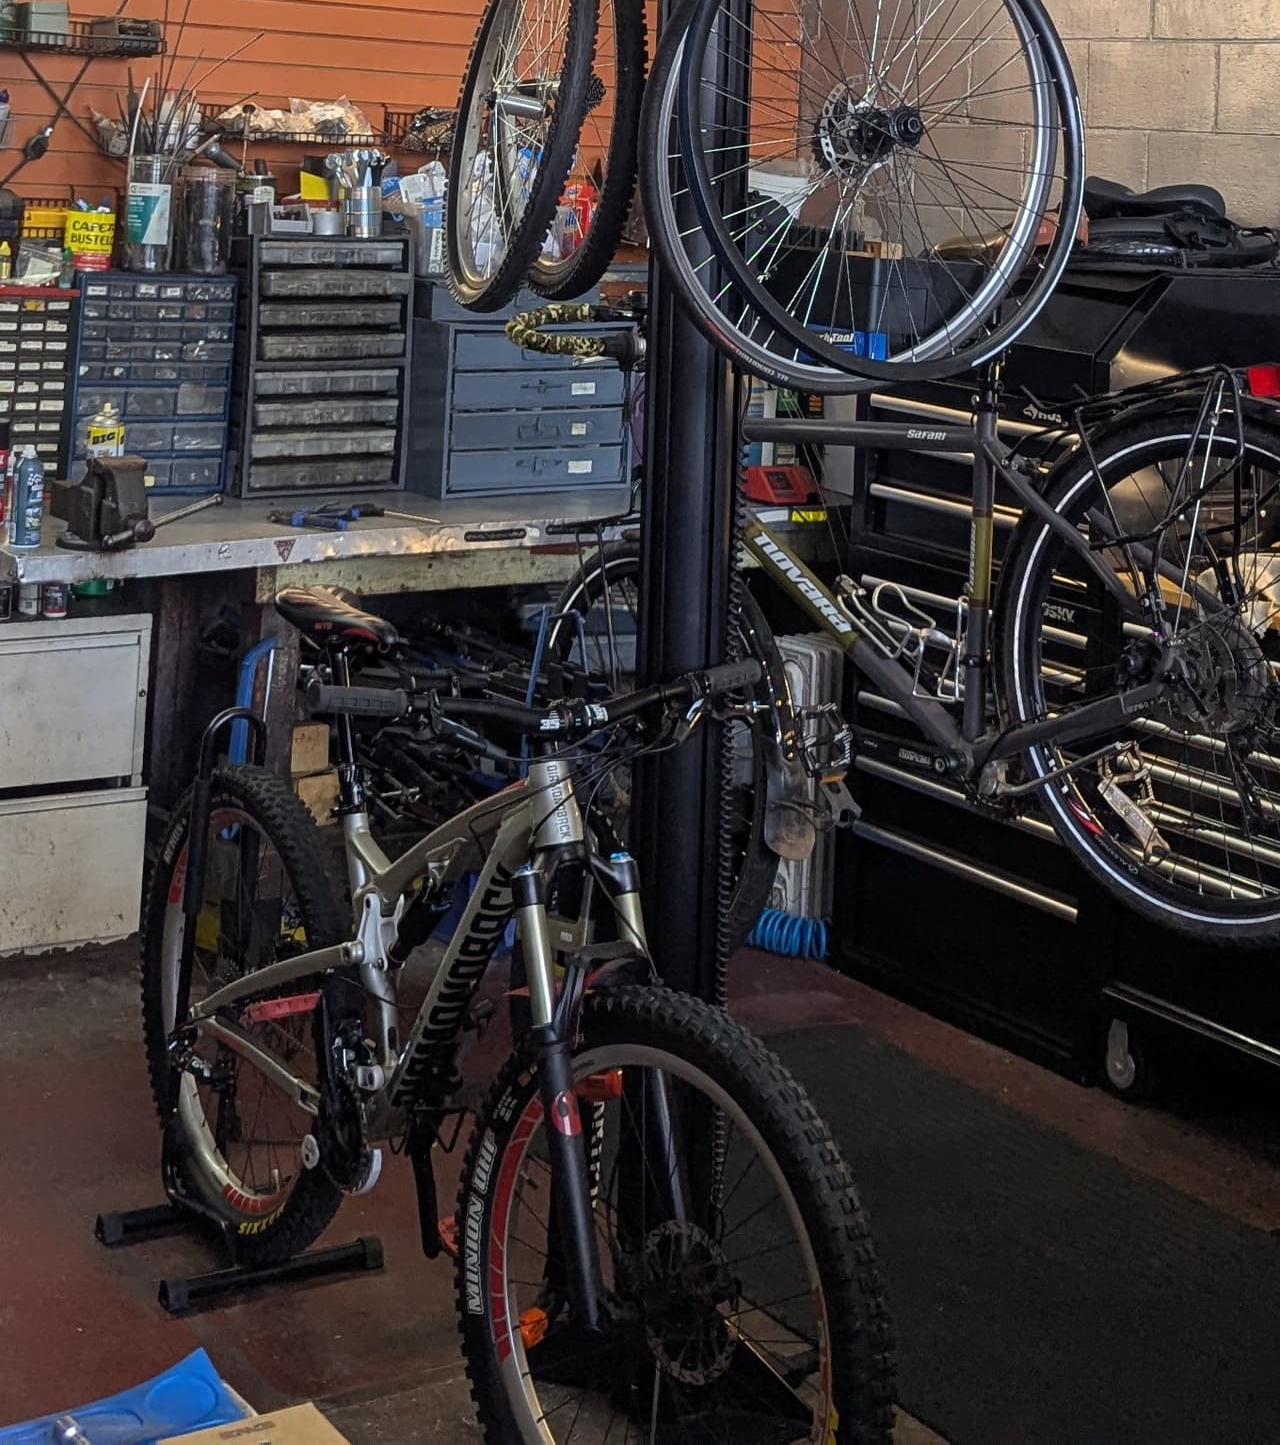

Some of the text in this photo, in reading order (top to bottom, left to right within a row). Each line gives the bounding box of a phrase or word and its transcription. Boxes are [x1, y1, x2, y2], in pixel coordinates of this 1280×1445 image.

[540, 718, 560, 730] 35
[546, 763, 572, 840] DIAMONDBACK
[464, 1197, 485, 1316] MINION
